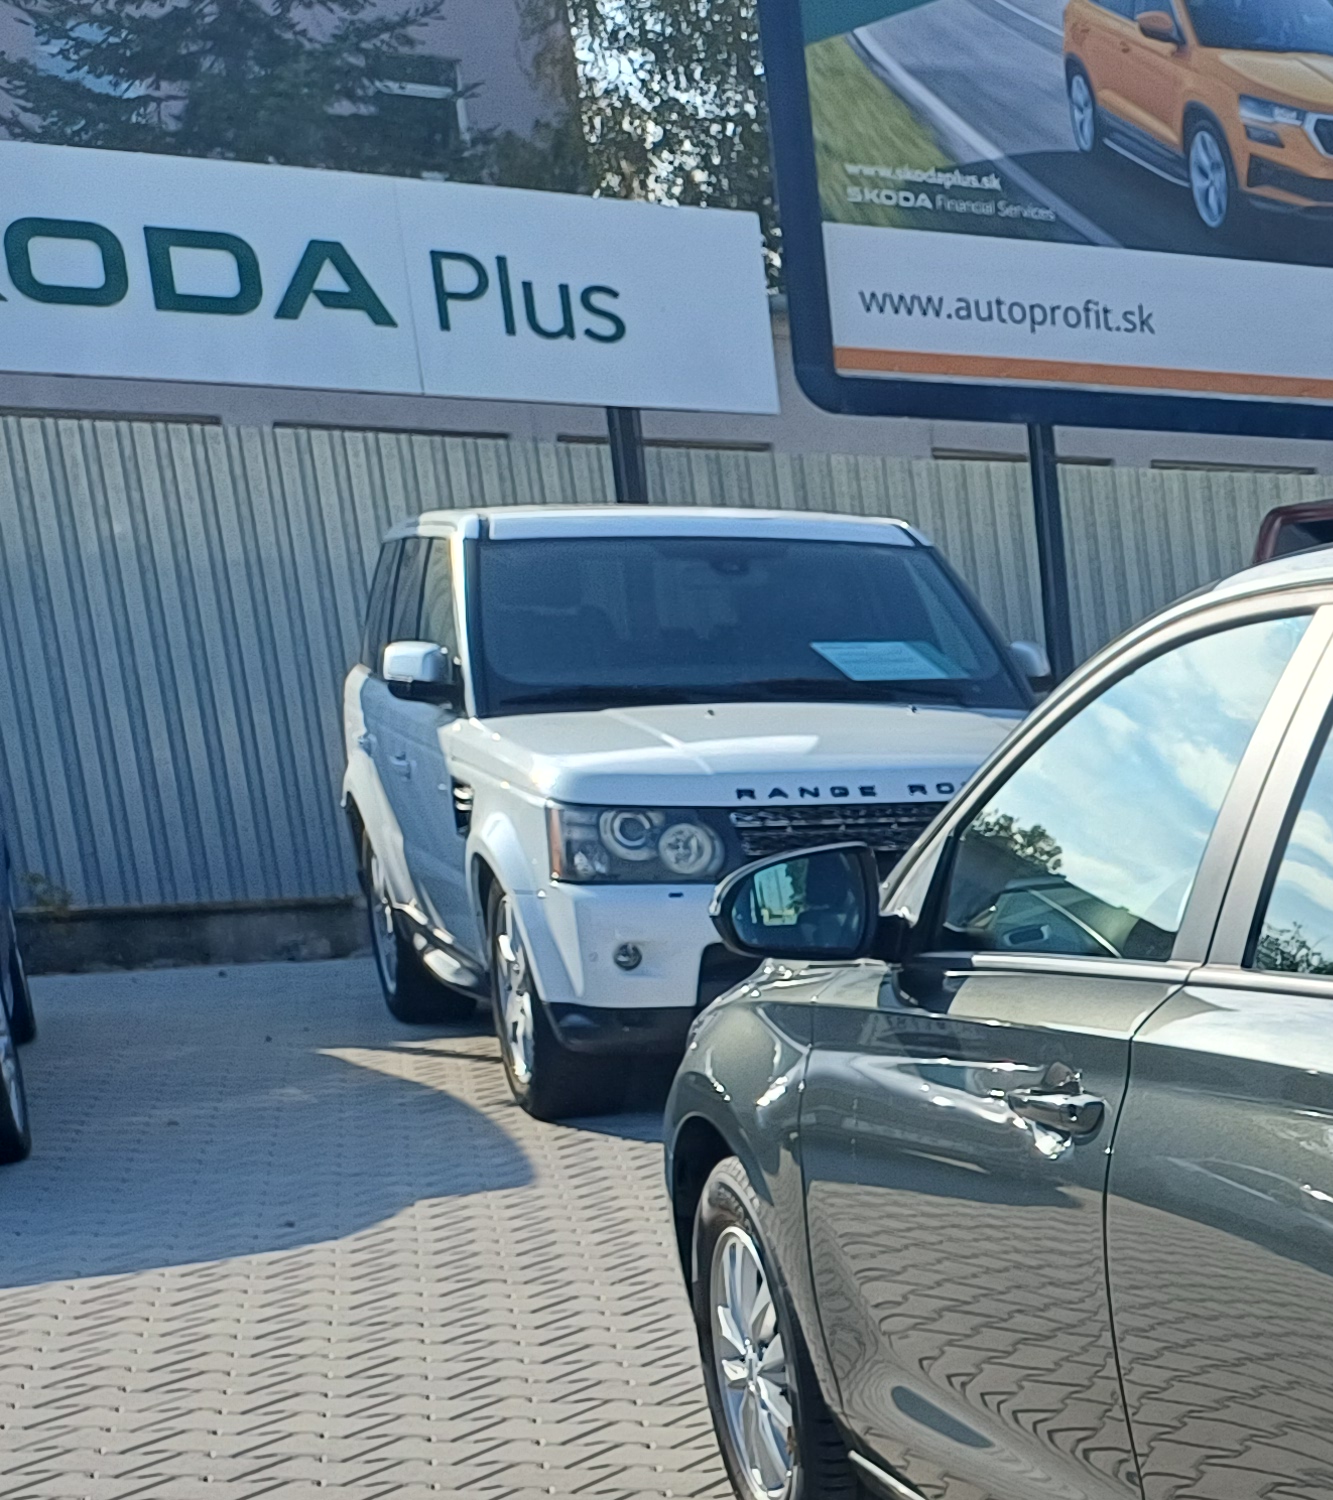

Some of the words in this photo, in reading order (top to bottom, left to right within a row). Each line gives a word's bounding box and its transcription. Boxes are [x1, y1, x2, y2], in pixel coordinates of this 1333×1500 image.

[0, 216, 398, 328] ODA
[429, 249, 627, 344] Plus
[858, 289, 1156, 335] www.autoprofit.sk
[736, 784, 878, 800] RANGE
